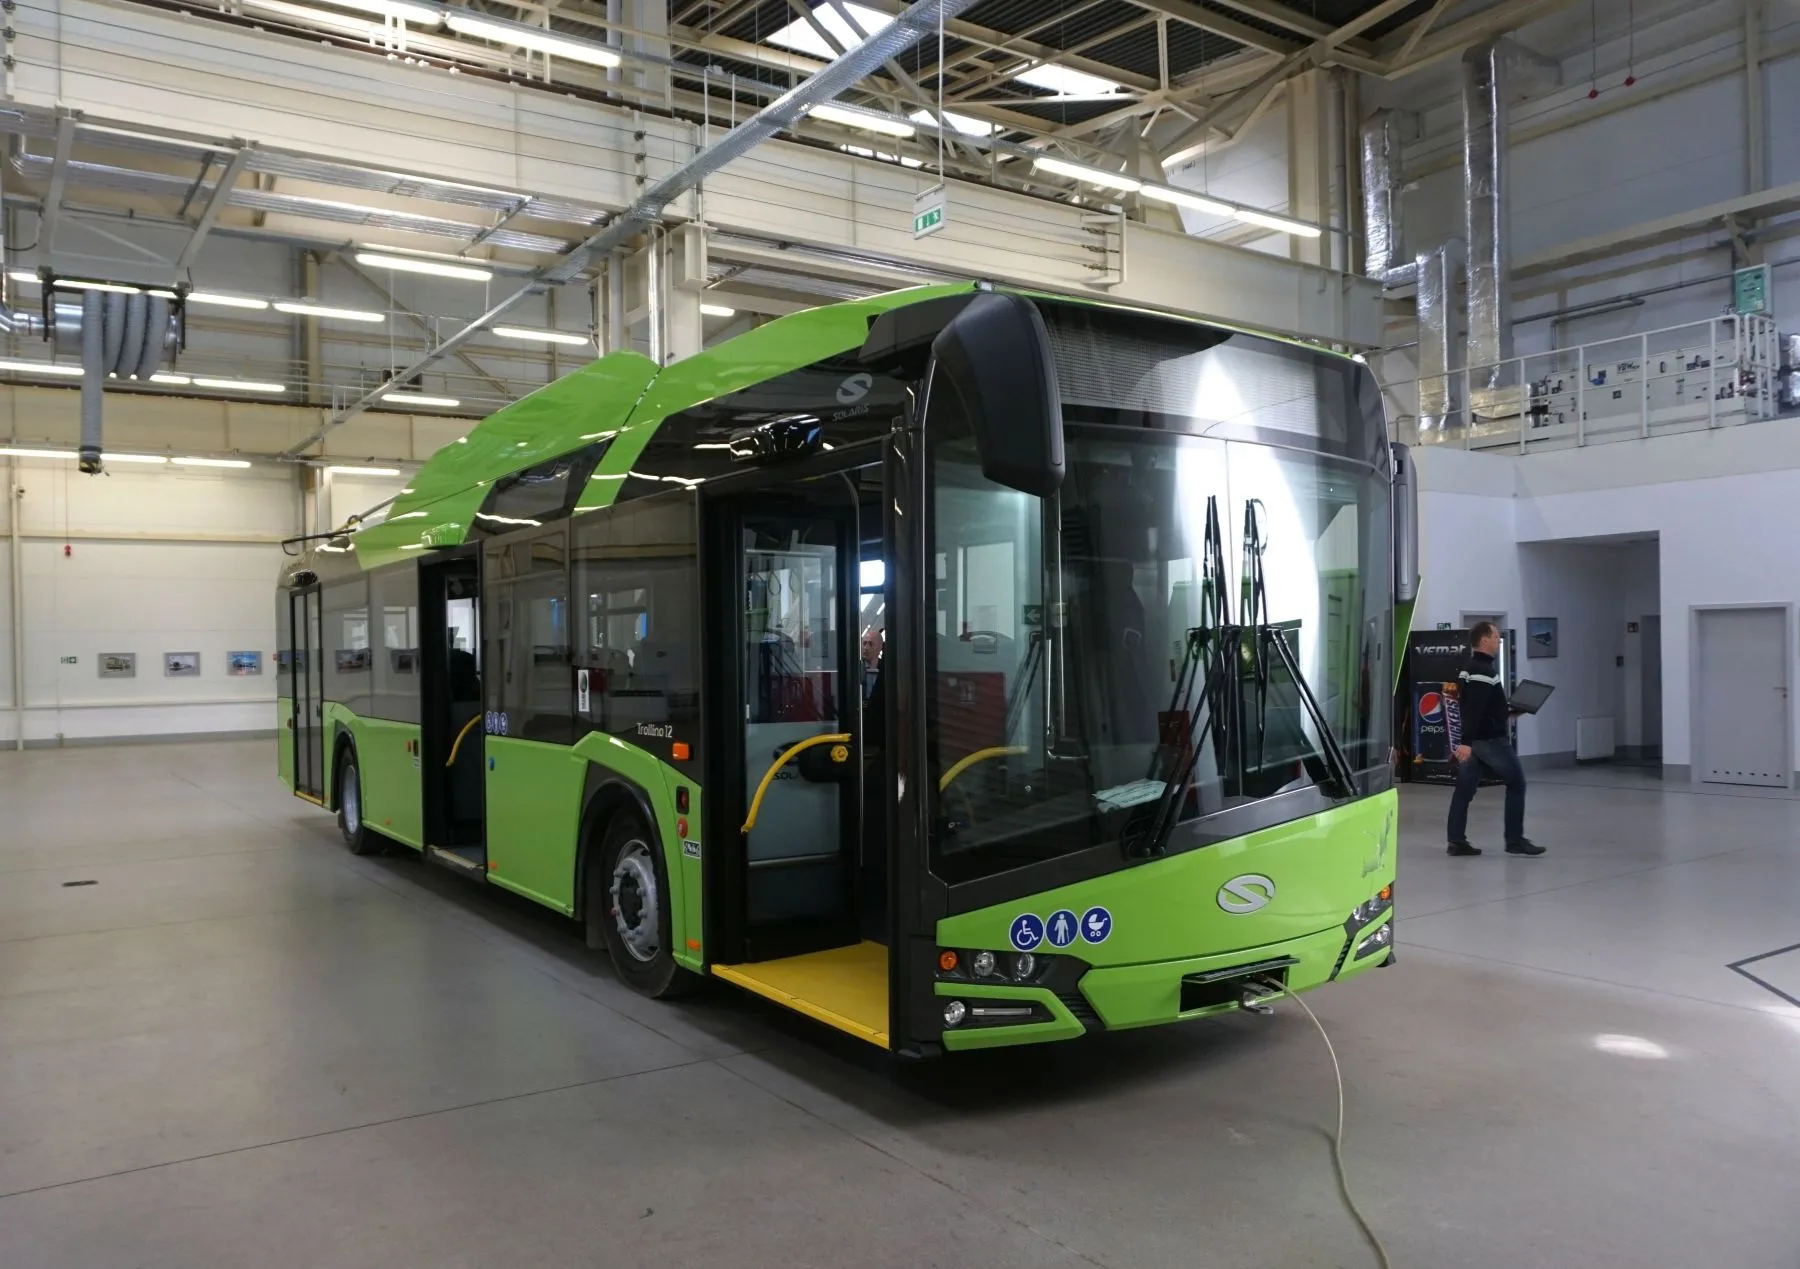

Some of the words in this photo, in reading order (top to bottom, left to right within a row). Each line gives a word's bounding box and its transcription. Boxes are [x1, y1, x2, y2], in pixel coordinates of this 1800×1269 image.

[832, 403, 870, 422] SOLARIS
[636, 722, 664, 737] Trollino
[665, 725, 673, 738] 12
[1420, 725, 1445, 734] peps
